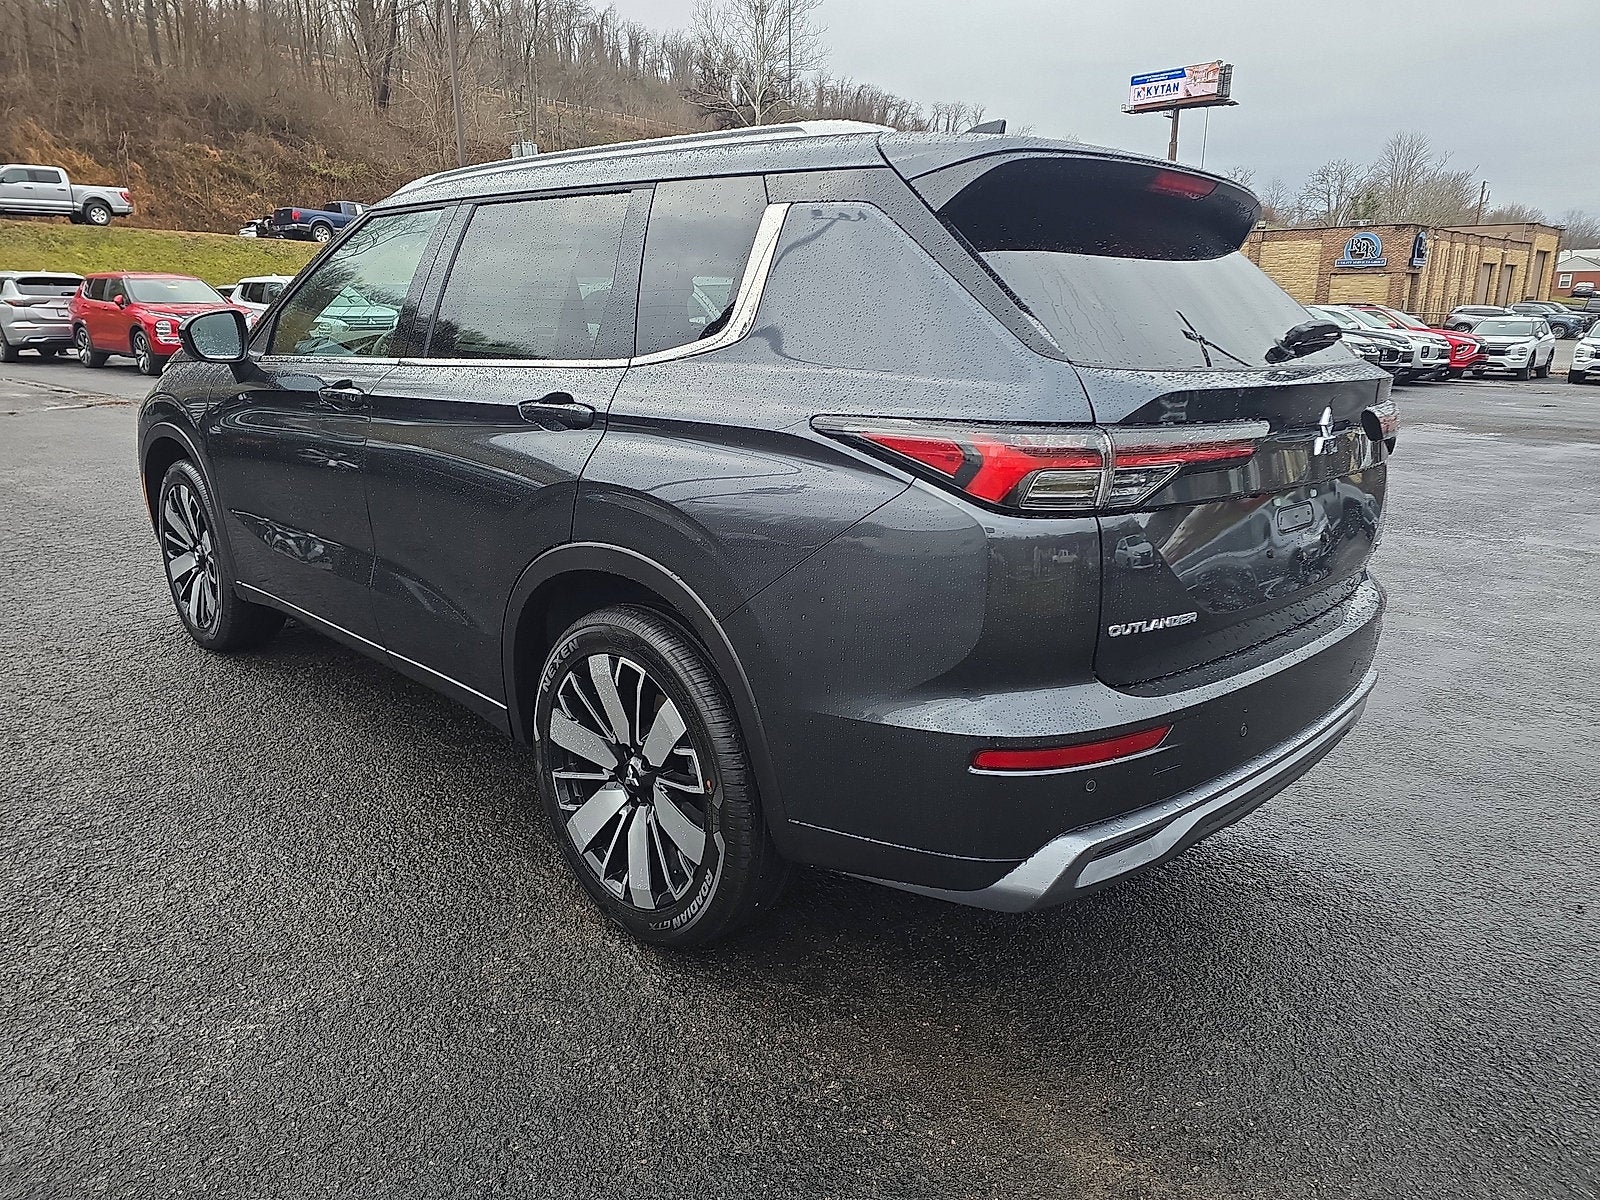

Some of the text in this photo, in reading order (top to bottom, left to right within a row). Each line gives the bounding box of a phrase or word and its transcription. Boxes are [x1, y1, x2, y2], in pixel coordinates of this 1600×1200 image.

[1146, 82, 1180, 97] KYTAN
[1108, 611, 1198, 637] OUTLANDER
[542, 638, 580, 693] NEXEN
[648, 867, 714, 931] ROADIAN GTX
